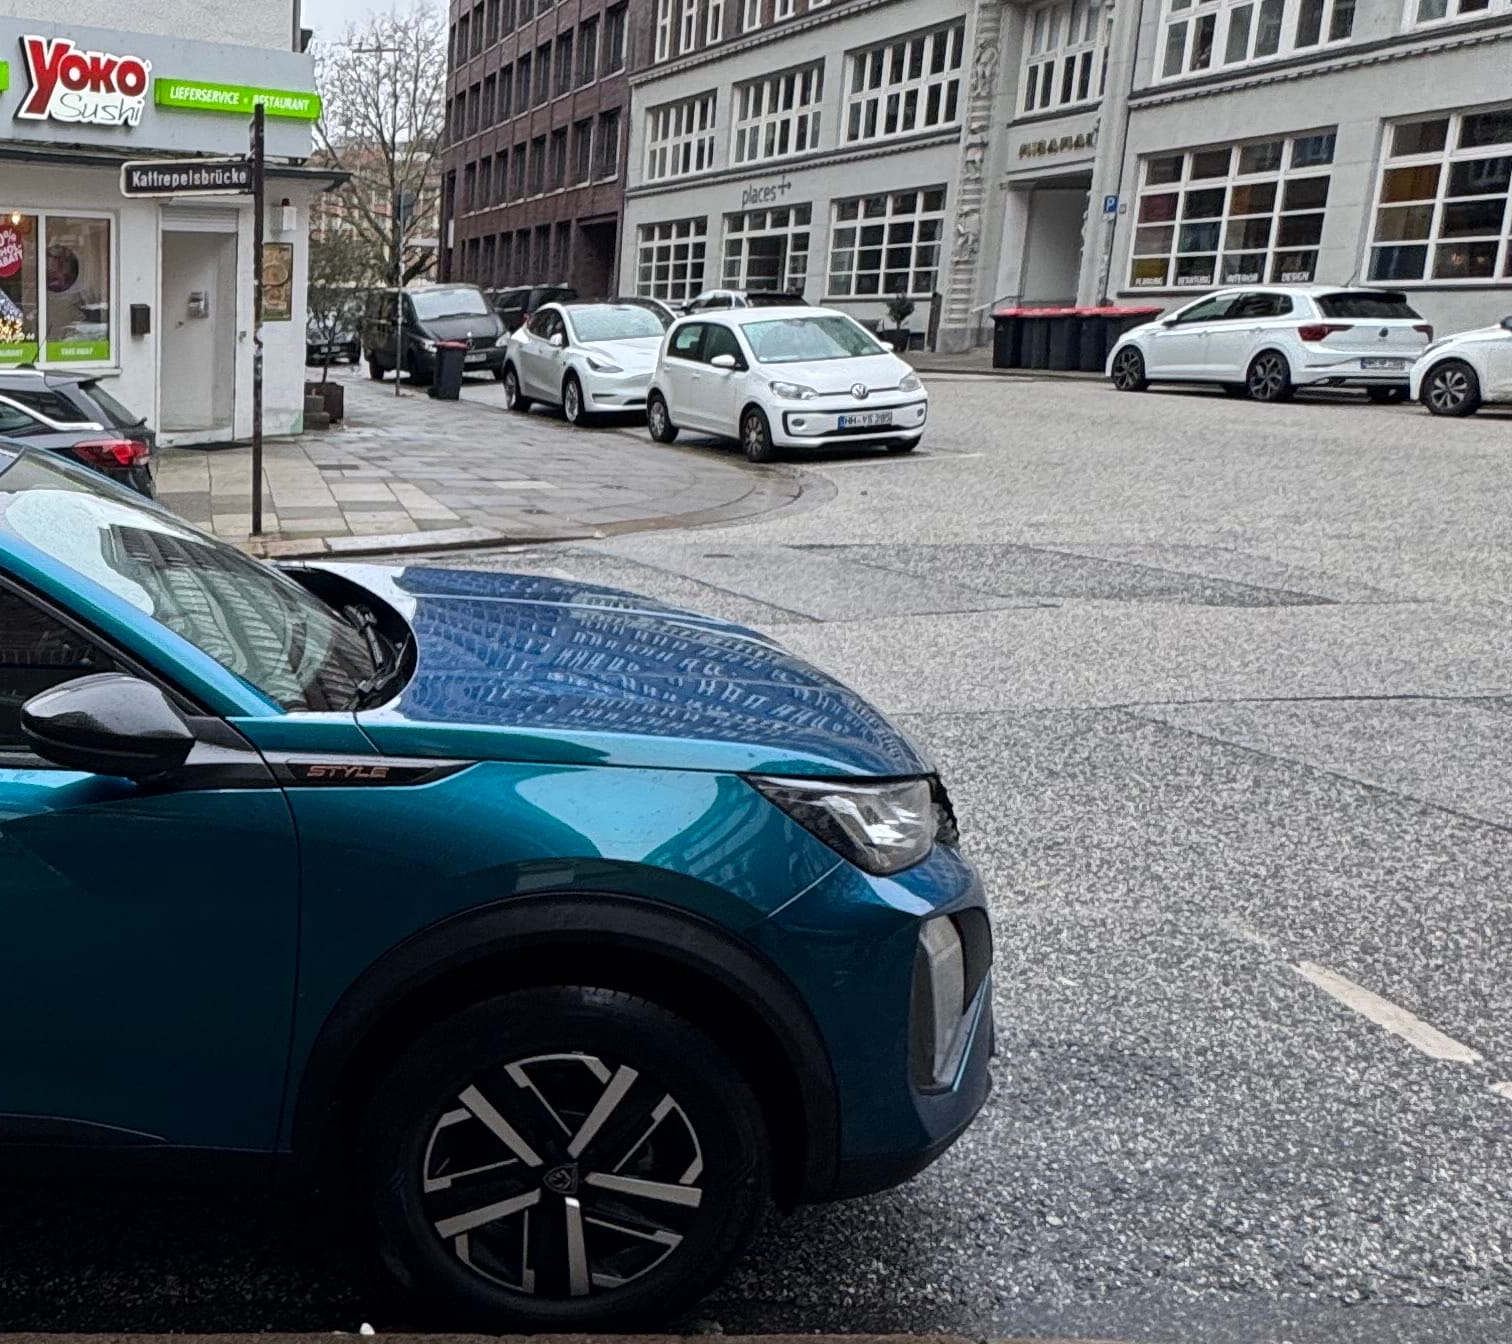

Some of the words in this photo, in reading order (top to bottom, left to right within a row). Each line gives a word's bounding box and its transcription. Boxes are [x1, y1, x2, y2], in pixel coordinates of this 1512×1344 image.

[28, 40, 146, 114] YOKO
[53, 92, 142, 124] Sushi
[169, 85, 240, 105] LIEFERSERVICE
[253, 94, 310, 111] RESTAURANT
[132, 167, 247, 188] Kattrepelsbrücke
[1106, 197, 1115, 212] P
[1281, 271, 1310, 282] DESIGN
[307, 765, 390, 778] STYLE
